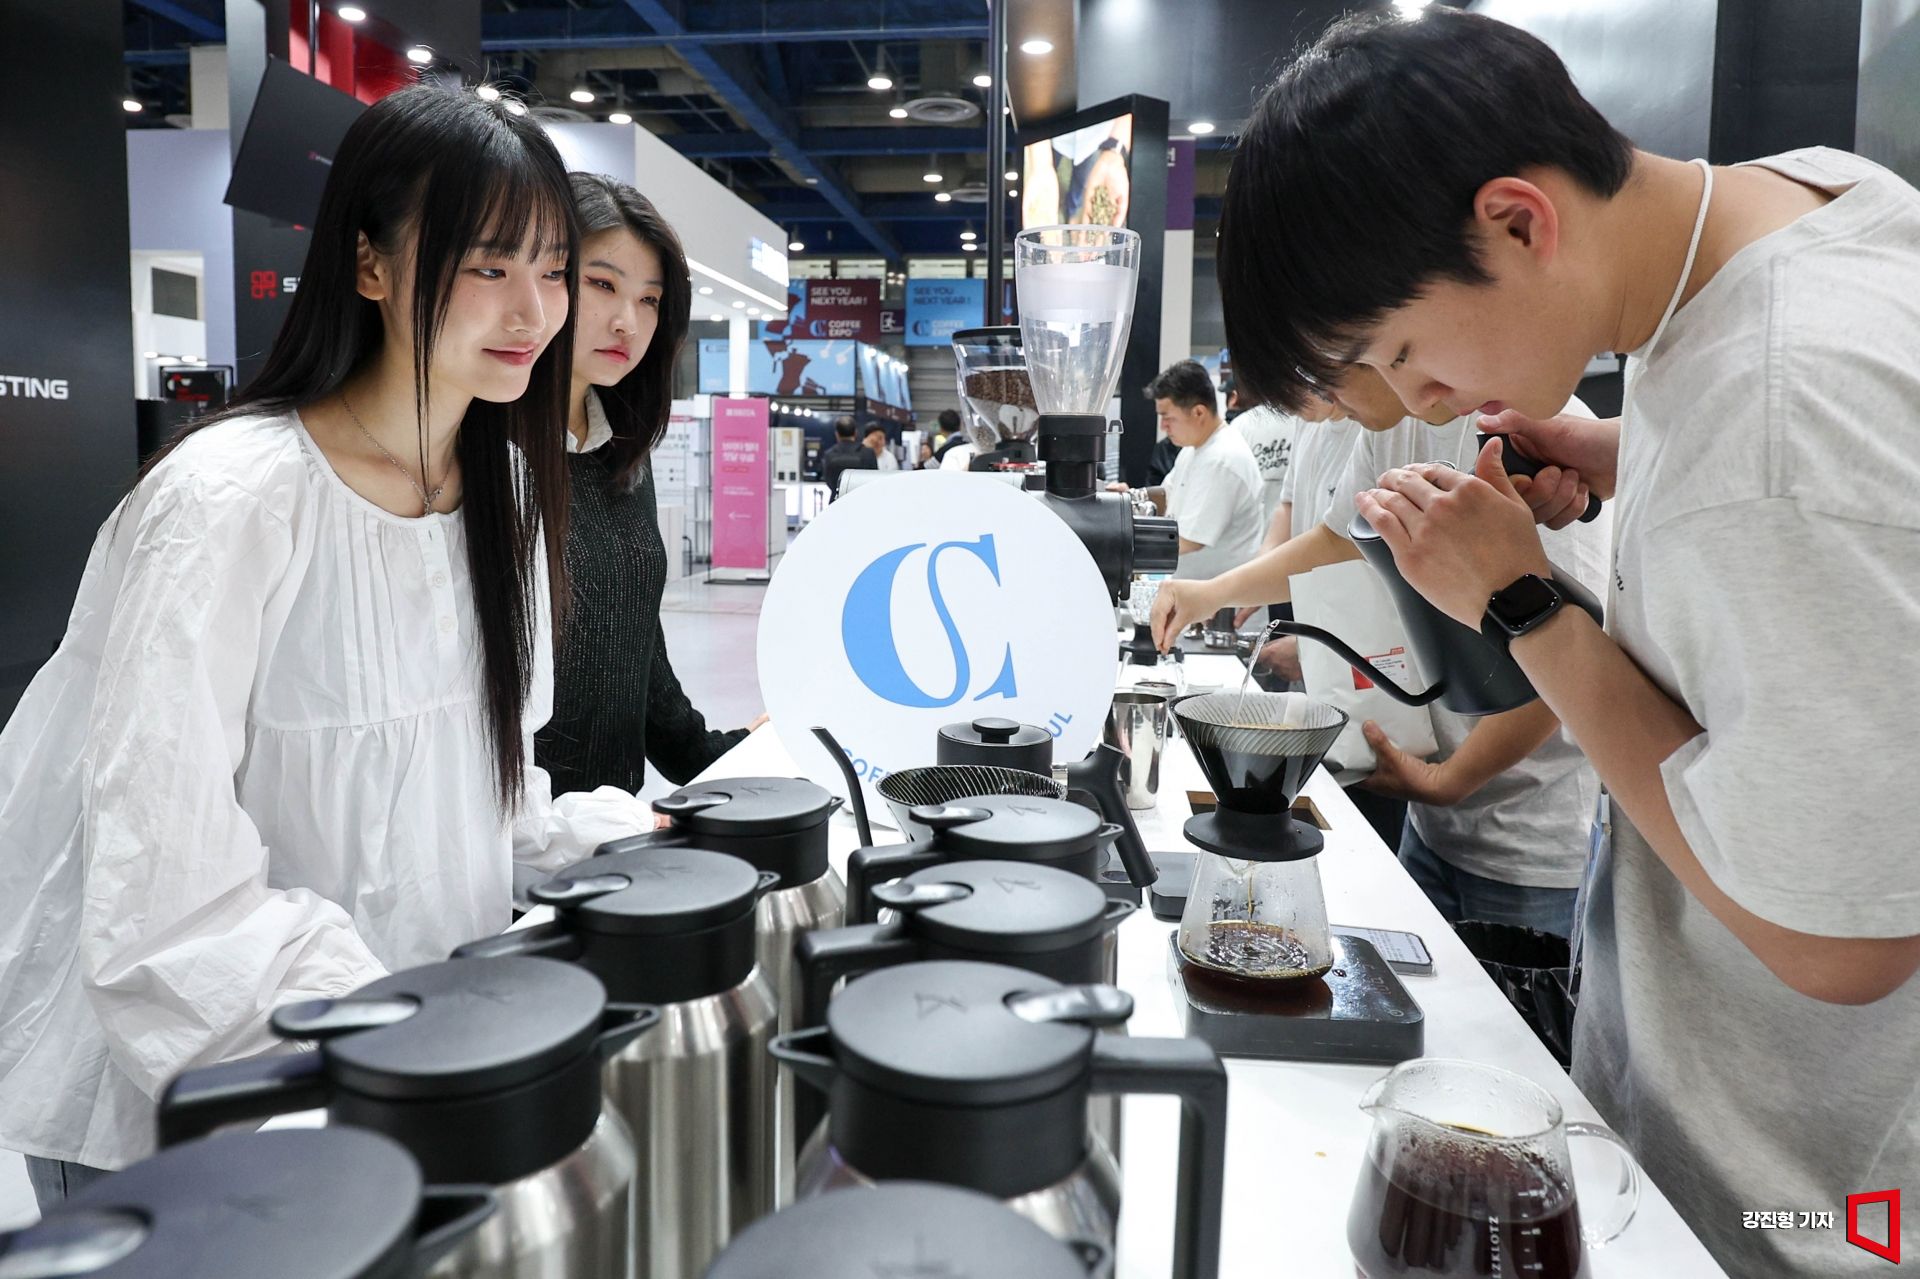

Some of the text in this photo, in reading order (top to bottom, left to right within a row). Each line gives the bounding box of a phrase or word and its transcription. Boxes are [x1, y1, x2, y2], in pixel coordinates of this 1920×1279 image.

[811, 287, 851, 296] SEE YOU
[811, 296, 836, 305] NEXT
[828, 320, 861, 329] COFFEE
